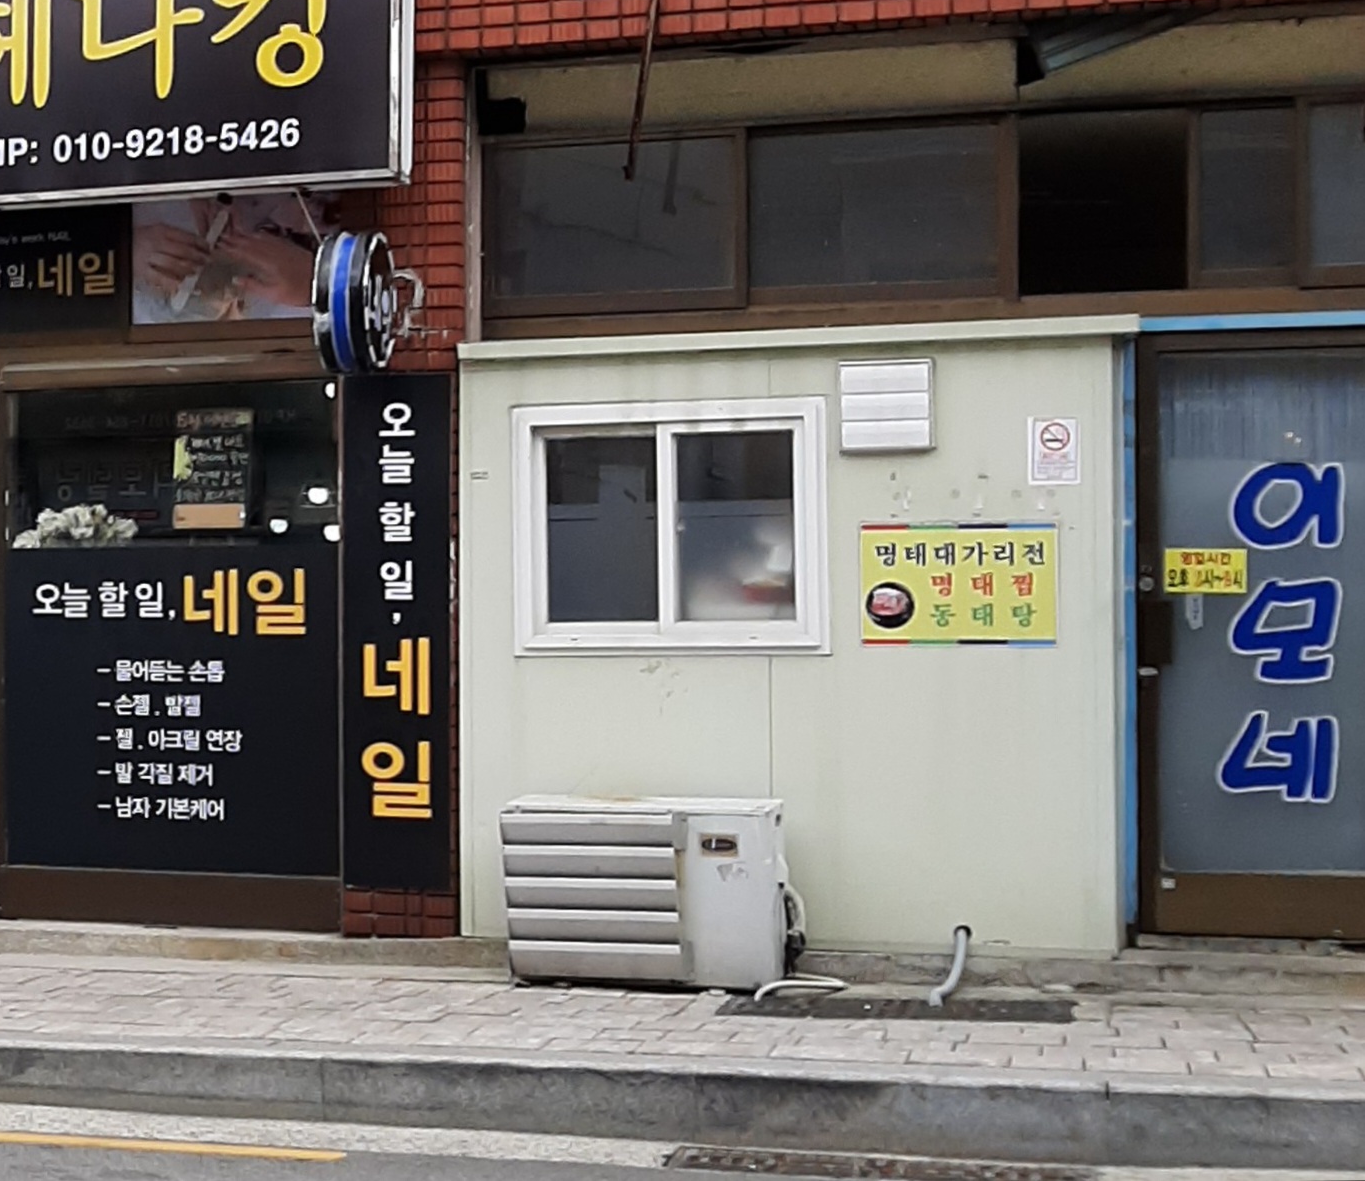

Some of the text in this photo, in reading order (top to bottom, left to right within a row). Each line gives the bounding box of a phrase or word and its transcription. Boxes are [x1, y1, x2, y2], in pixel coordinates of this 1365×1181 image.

[53, 118, 300, 164] 010-9218-5426
[7, 264, 33, 291] 일,
[37, 249, 115, 297] 네일
[378, 402, 416, 484] 오늘
[378, 502, 416, 542] 할
[874, 541, 1046, 567] 명태대가리전
[32, 568, 307, 636] 오늘 할 일, 네일
[930, 603, 1038, 628] 동태탕
[115, 659, 225, 683] 물어뜯는 손톱
[114, 693, 150, 716] 손젤
[148, 728, 200, 751] 아크릴
[205, 729, 243, 752] 연장
[361, 637, 432, 818] 네일
[115, 762, 214, 787] 발 각질 제거
[115, 796, 225, 821] 남자 기본케어
